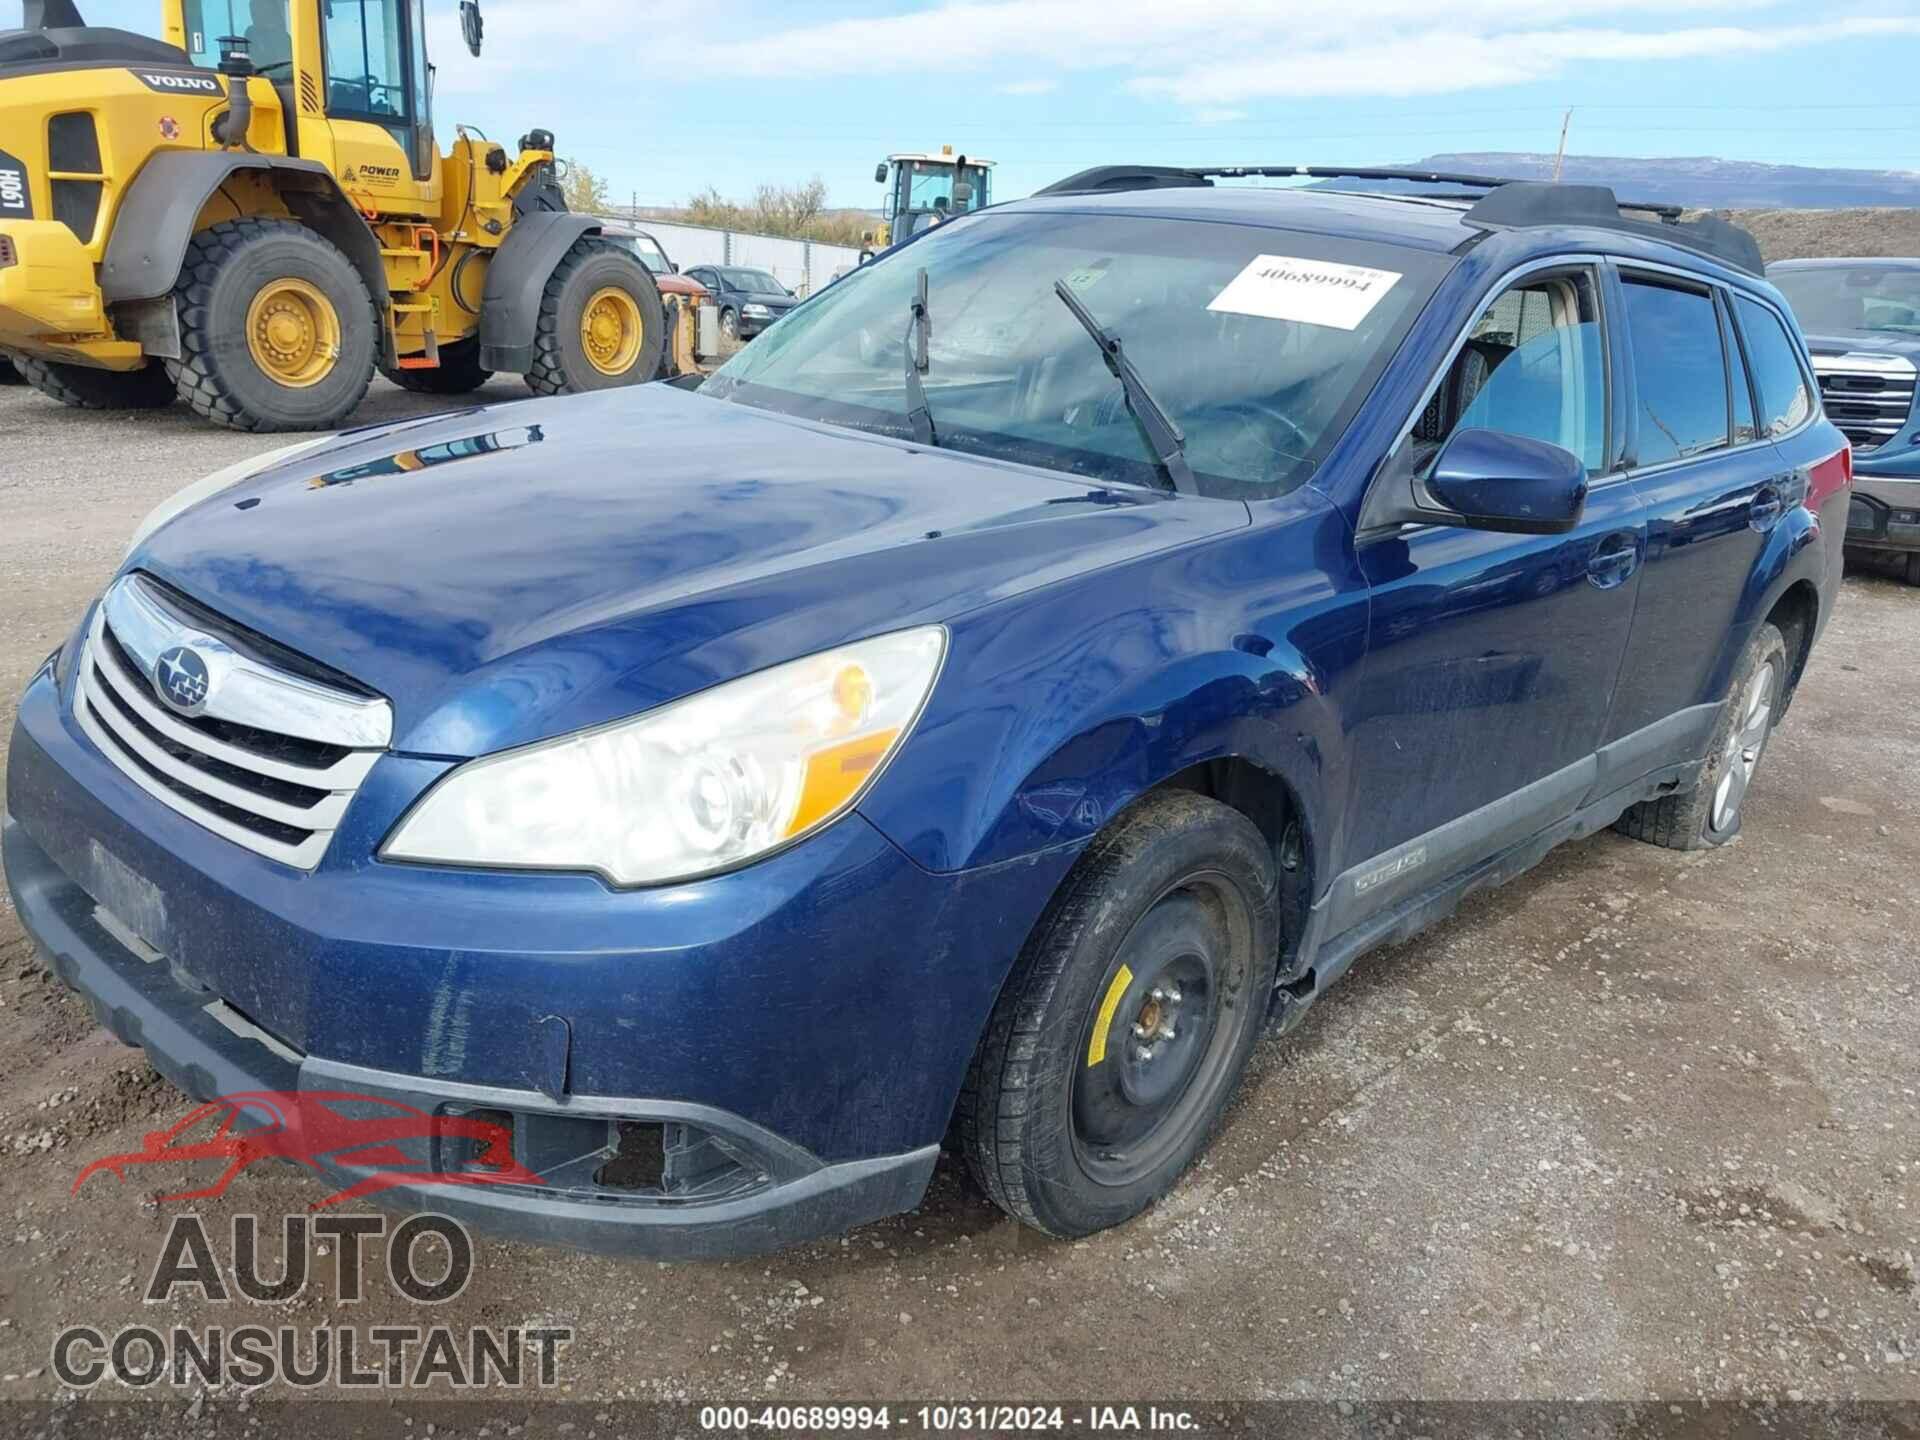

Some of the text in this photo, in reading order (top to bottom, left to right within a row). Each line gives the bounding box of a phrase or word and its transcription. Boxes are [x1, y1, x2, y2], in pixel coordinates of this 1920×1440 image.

[143, 74, 217, 91] VOLVO
[359, 164, 400, 177] POWER
[0, 169, 24, 208] L90H
[1256, 267, 1374, 293] 40689994
